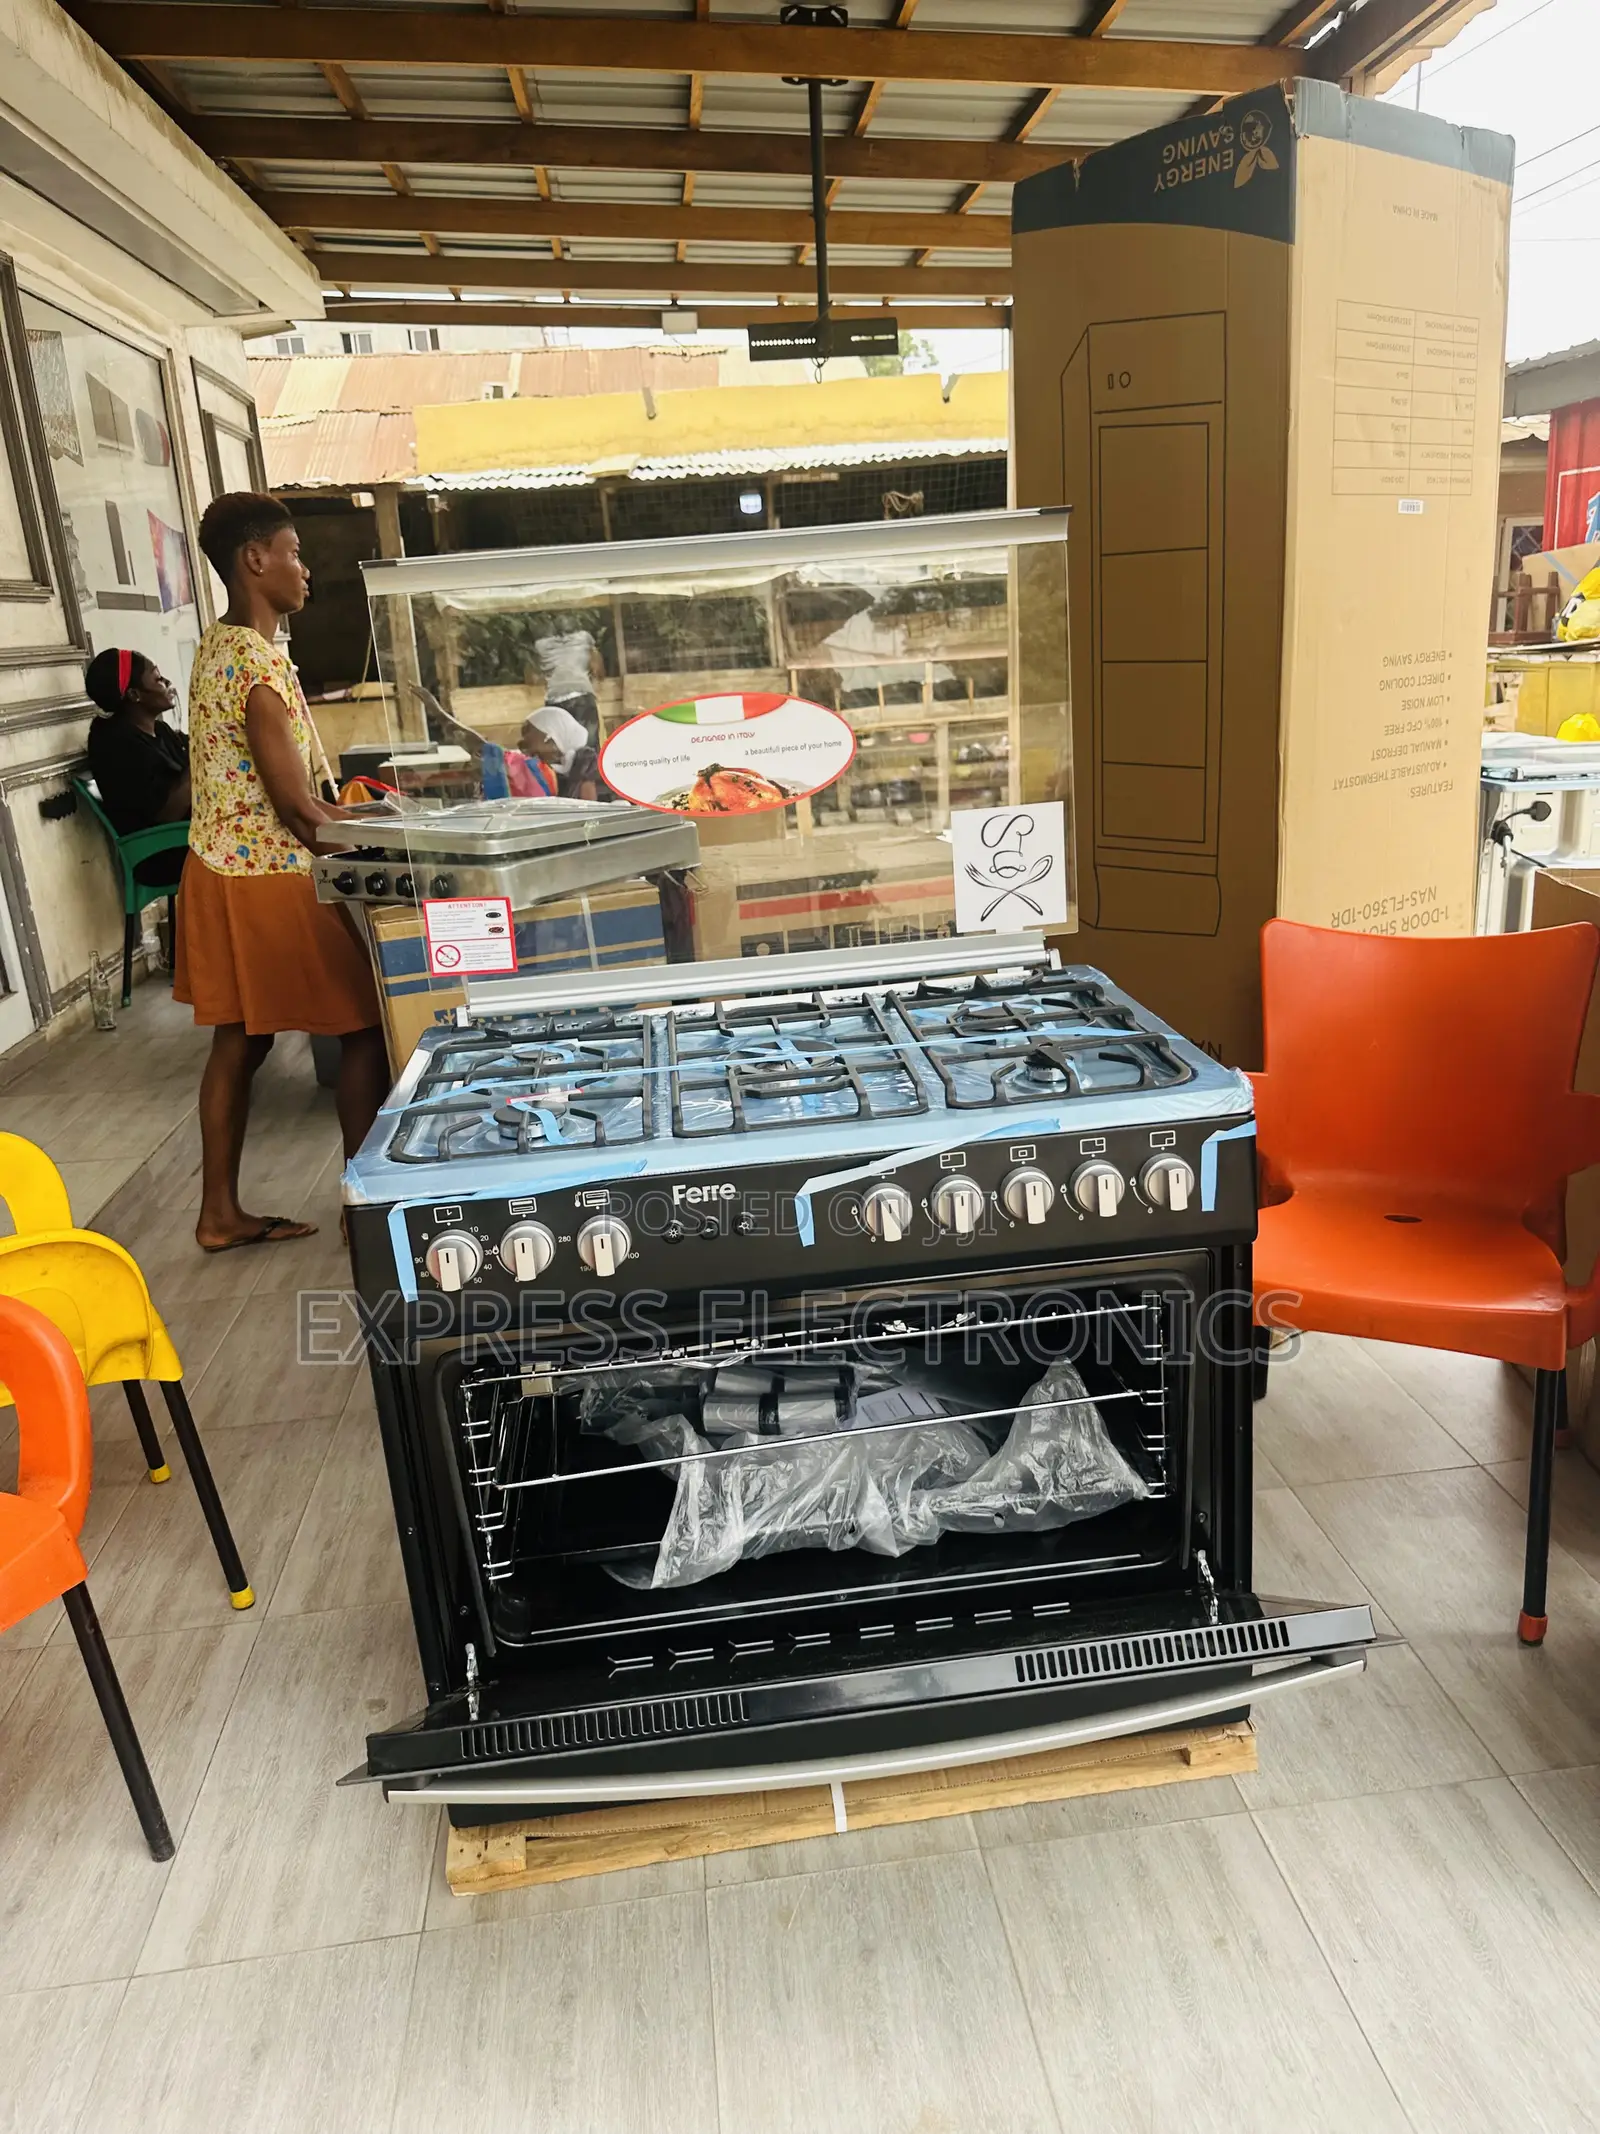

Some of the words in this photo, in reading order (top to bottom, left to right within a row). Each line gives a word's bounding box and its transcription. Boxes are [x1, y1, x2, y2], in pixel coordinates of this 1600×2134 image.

[1162, 125, 1234, 164] SAVING
[1153, 148, 1234, 193] ENERGY
[1382, 653, 1413, 668] SAVING
[1415, 650, 1446, 664] ENERGY
[1379, 676, 1416, 691] COOLING
[1416, 672, 1445, 687] DIRECT
[1401, 697, 1425, 711] NOISE
[1426, 694, 1444, 707] LOW
[1384, 724, 1405, 736] FREE
[1406, 720, 1423, 732] CFC
[781, 744, 799, 754] piece
[799, 743, 807, 751] of
[808, 742, 823, 751] your
[824, 740, 842, 749] home
[1371, 744, 1409, 761] DEFROST
[1410, 738, 1442, 754] MANUAL
[614, 758, 648, 769] improving
[648, 756, 671, 766] quality
[672, 755, 679, 763] of
[680, 754, 691, 762] life
[1390, 760, 1441, 780] ADJUSTABLE
[1332, 770, 1390, 791] THERMOSTAT
[1331, 885, 1437, 929] NAS-FL360-1DR
[1401, 905, 1449, 932] 1-DOOR
[671, 1183, 737, 1206] Ferre
[480, 1234, 489, 1242] 20
[557, 1235, 572, 1243] 280
[414, 1256, 424, 1264] 90
[626, 1251, 640, 1259] 100
[473, 1276, 483, 1284] 50
